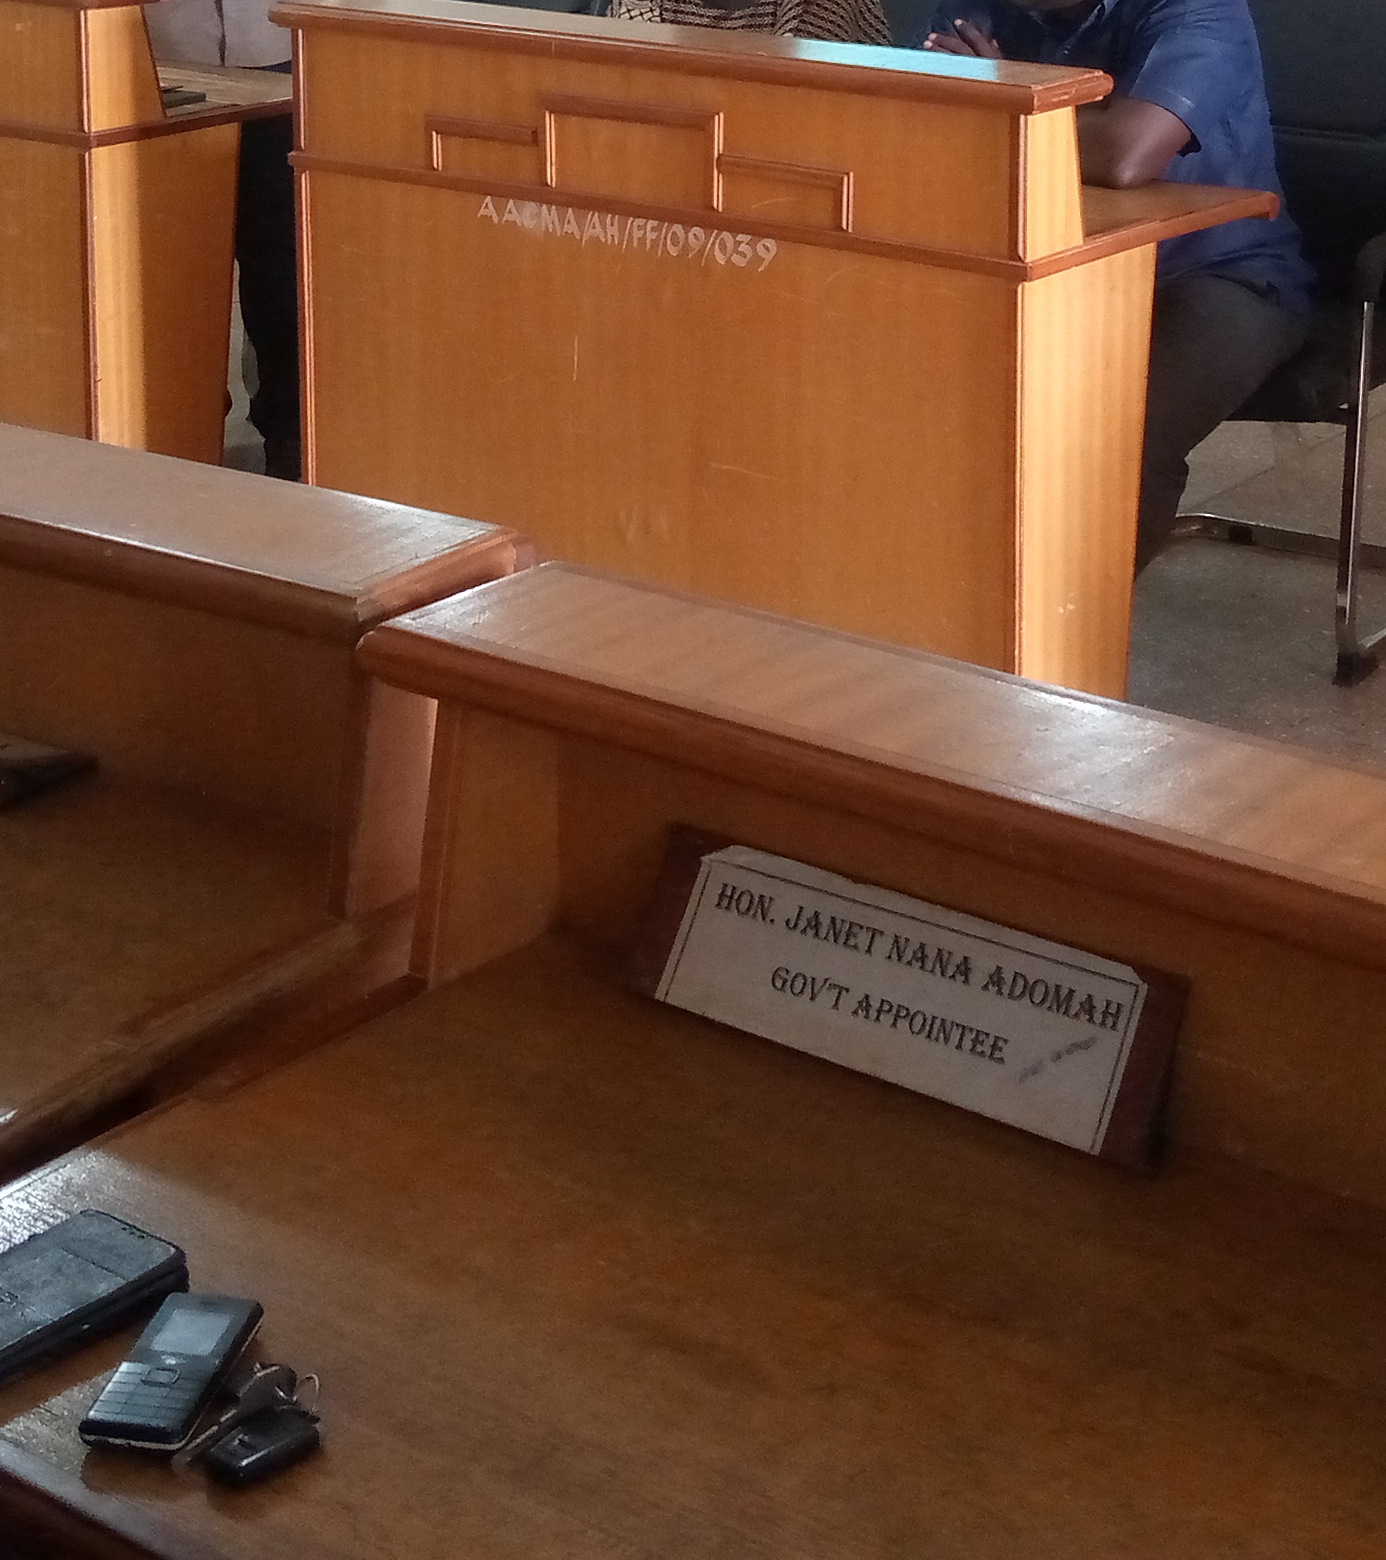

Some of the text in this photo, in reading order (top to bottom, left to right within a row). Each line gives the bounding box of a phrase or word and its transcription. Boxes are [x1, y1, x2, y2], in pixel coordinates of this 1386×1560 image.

[715, 882, 1126, 1032] HON. JANET NANA ADOMAH
[771, 966, 1008, 1066] GOV'T APPOINTEE
